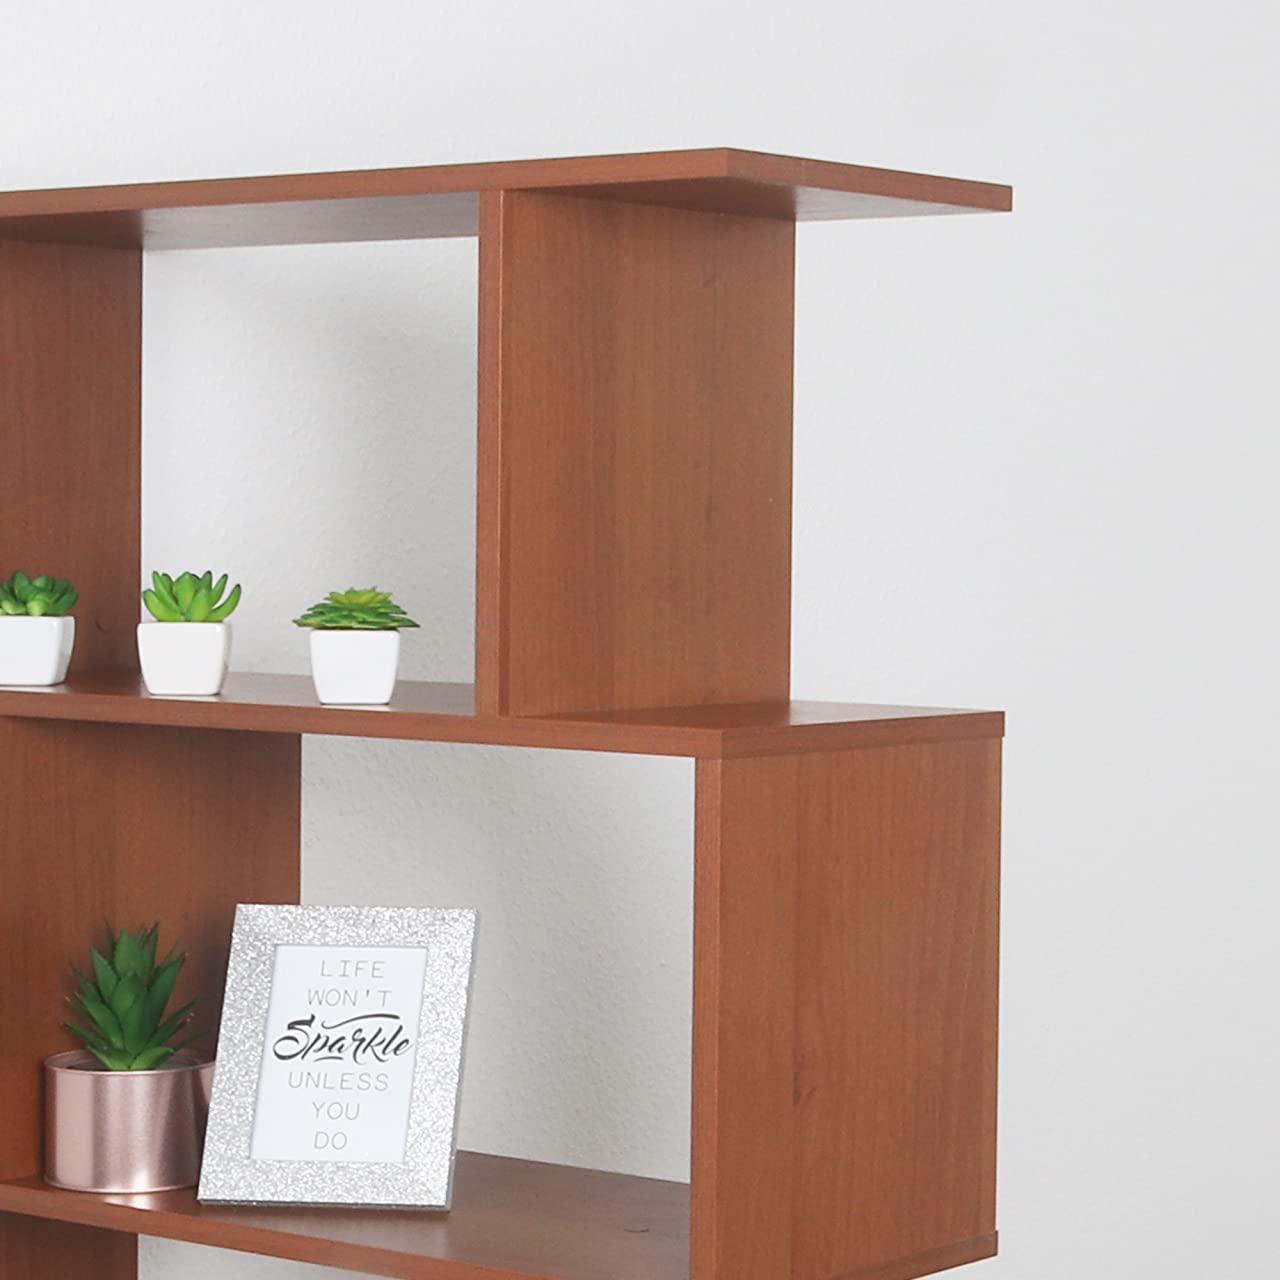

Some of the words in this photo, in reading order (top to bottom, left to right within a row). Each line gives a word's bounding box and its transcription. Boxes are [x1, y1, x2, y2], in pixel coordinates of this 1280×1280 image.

[320, 959, 385, 978] LIFE
[307, 988, 392, 1008] WON'T
[272, 1013, 416, 1066] Sparkle
[288, 1072, 389, 1092] UNLESS
[311, 1102, 361, 1121] YOU
[313, 1131, 348, 1150] DO
